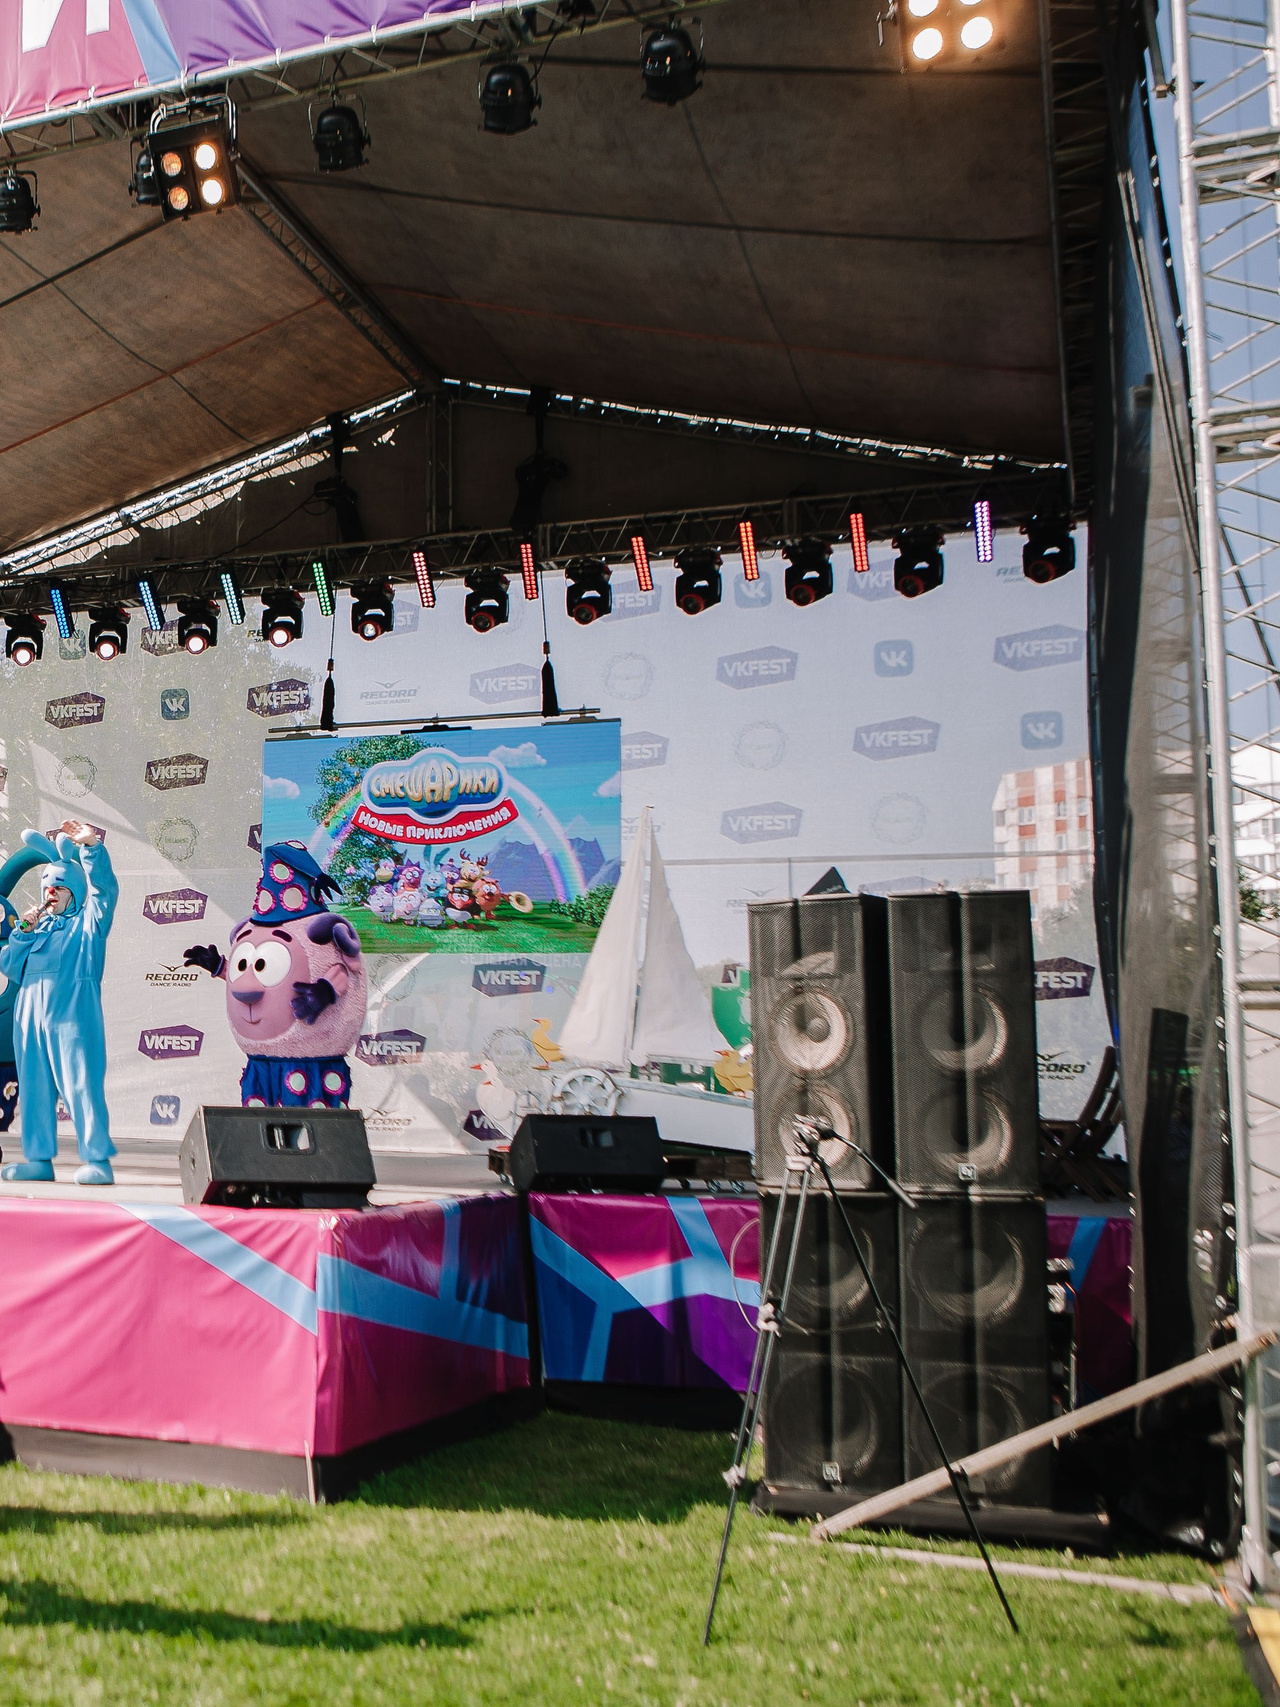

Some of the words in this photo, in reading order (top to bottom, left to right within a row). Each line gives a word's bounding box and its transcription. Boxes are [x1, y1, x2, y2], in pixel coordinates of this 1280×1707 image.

[855, 570, 892, 588] VKF
[740, 580, 766, 598] VK
[616, 592, 655, 608] FEST
[1002, 638, 1078, 659] VKFEST
[880, 650, 908, 668] VK
[724, 659, 792, 677] VKFEST
[475, 676, 537, 691] VKFEST
[252, 690, 308, 706] VKFEST
[360, 689, 418, 700] RECORD
[50, 703, 100, 718] VKFEST
[164, 698, 186, 712] VK
[861, 730, 933, 748] VKFEST
[1027, 722, 1057, 740] VK
[622, 743, 662, 759] FEST
[150, 765, 203, 780] VKFEST
[370, 761, 499, 804] СМЕШАРИКИ
[358, 811, 404, 837] НОВЫЕ
[406, 806, 512, 840] ПРИКЛЮЧЕНИЯ
[728, 814, 796, 832] VKFEST
[148, 899, 203, 914] VKFEST
[145, 973, 199, 981] RECORD
[478, 970, 540, 985] VKFEST
[1035, 971, 1087, 988] FEST
[144, 1034, 199, 1050] VKFEST
[361, 1040, 421, 1056] VKFEST
[155, 1102, 176, 1118] VK
